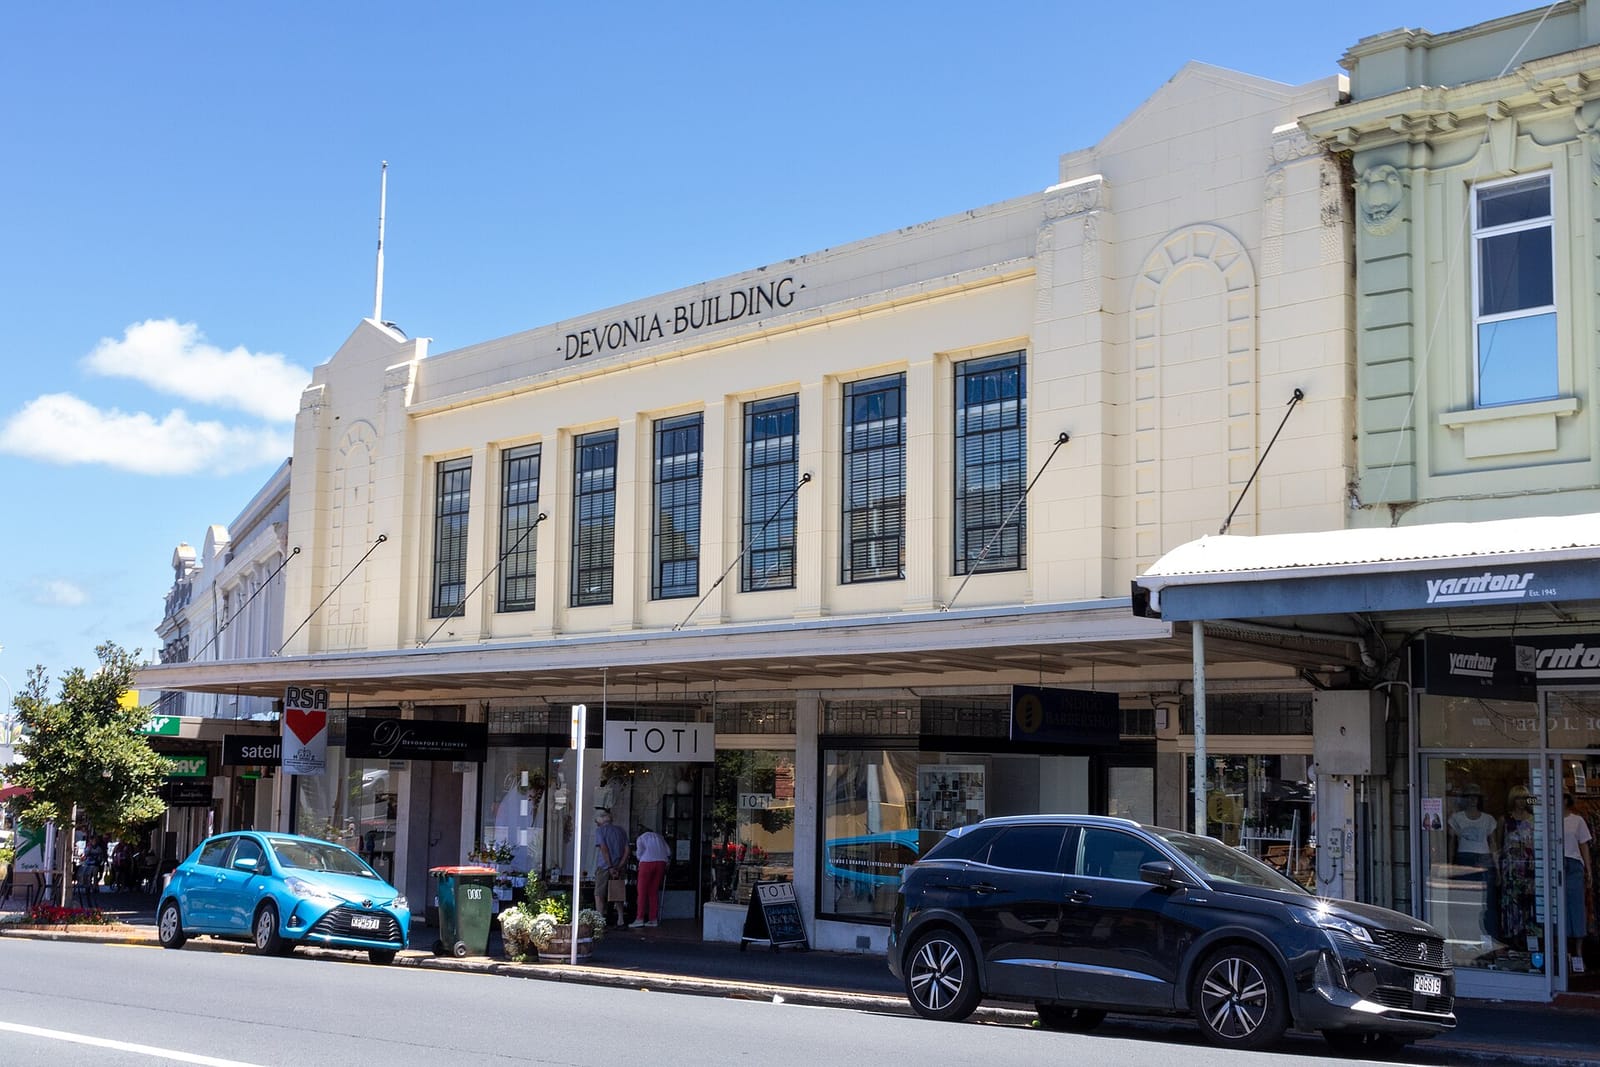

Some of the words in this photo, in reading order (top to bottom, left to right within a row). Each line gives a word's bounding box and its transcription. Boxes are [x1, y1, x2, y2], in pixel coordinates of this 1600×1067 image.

[565, 312, 663, 361] DEVONIA
[673, 277, 796, 335] BUILDING
[286, 687, 328, 709] RSA
[624, 728, 697, 753] TOTI
[741, 795, 770, 808] TOTI
[760, 885, 792, 898] TOTI
